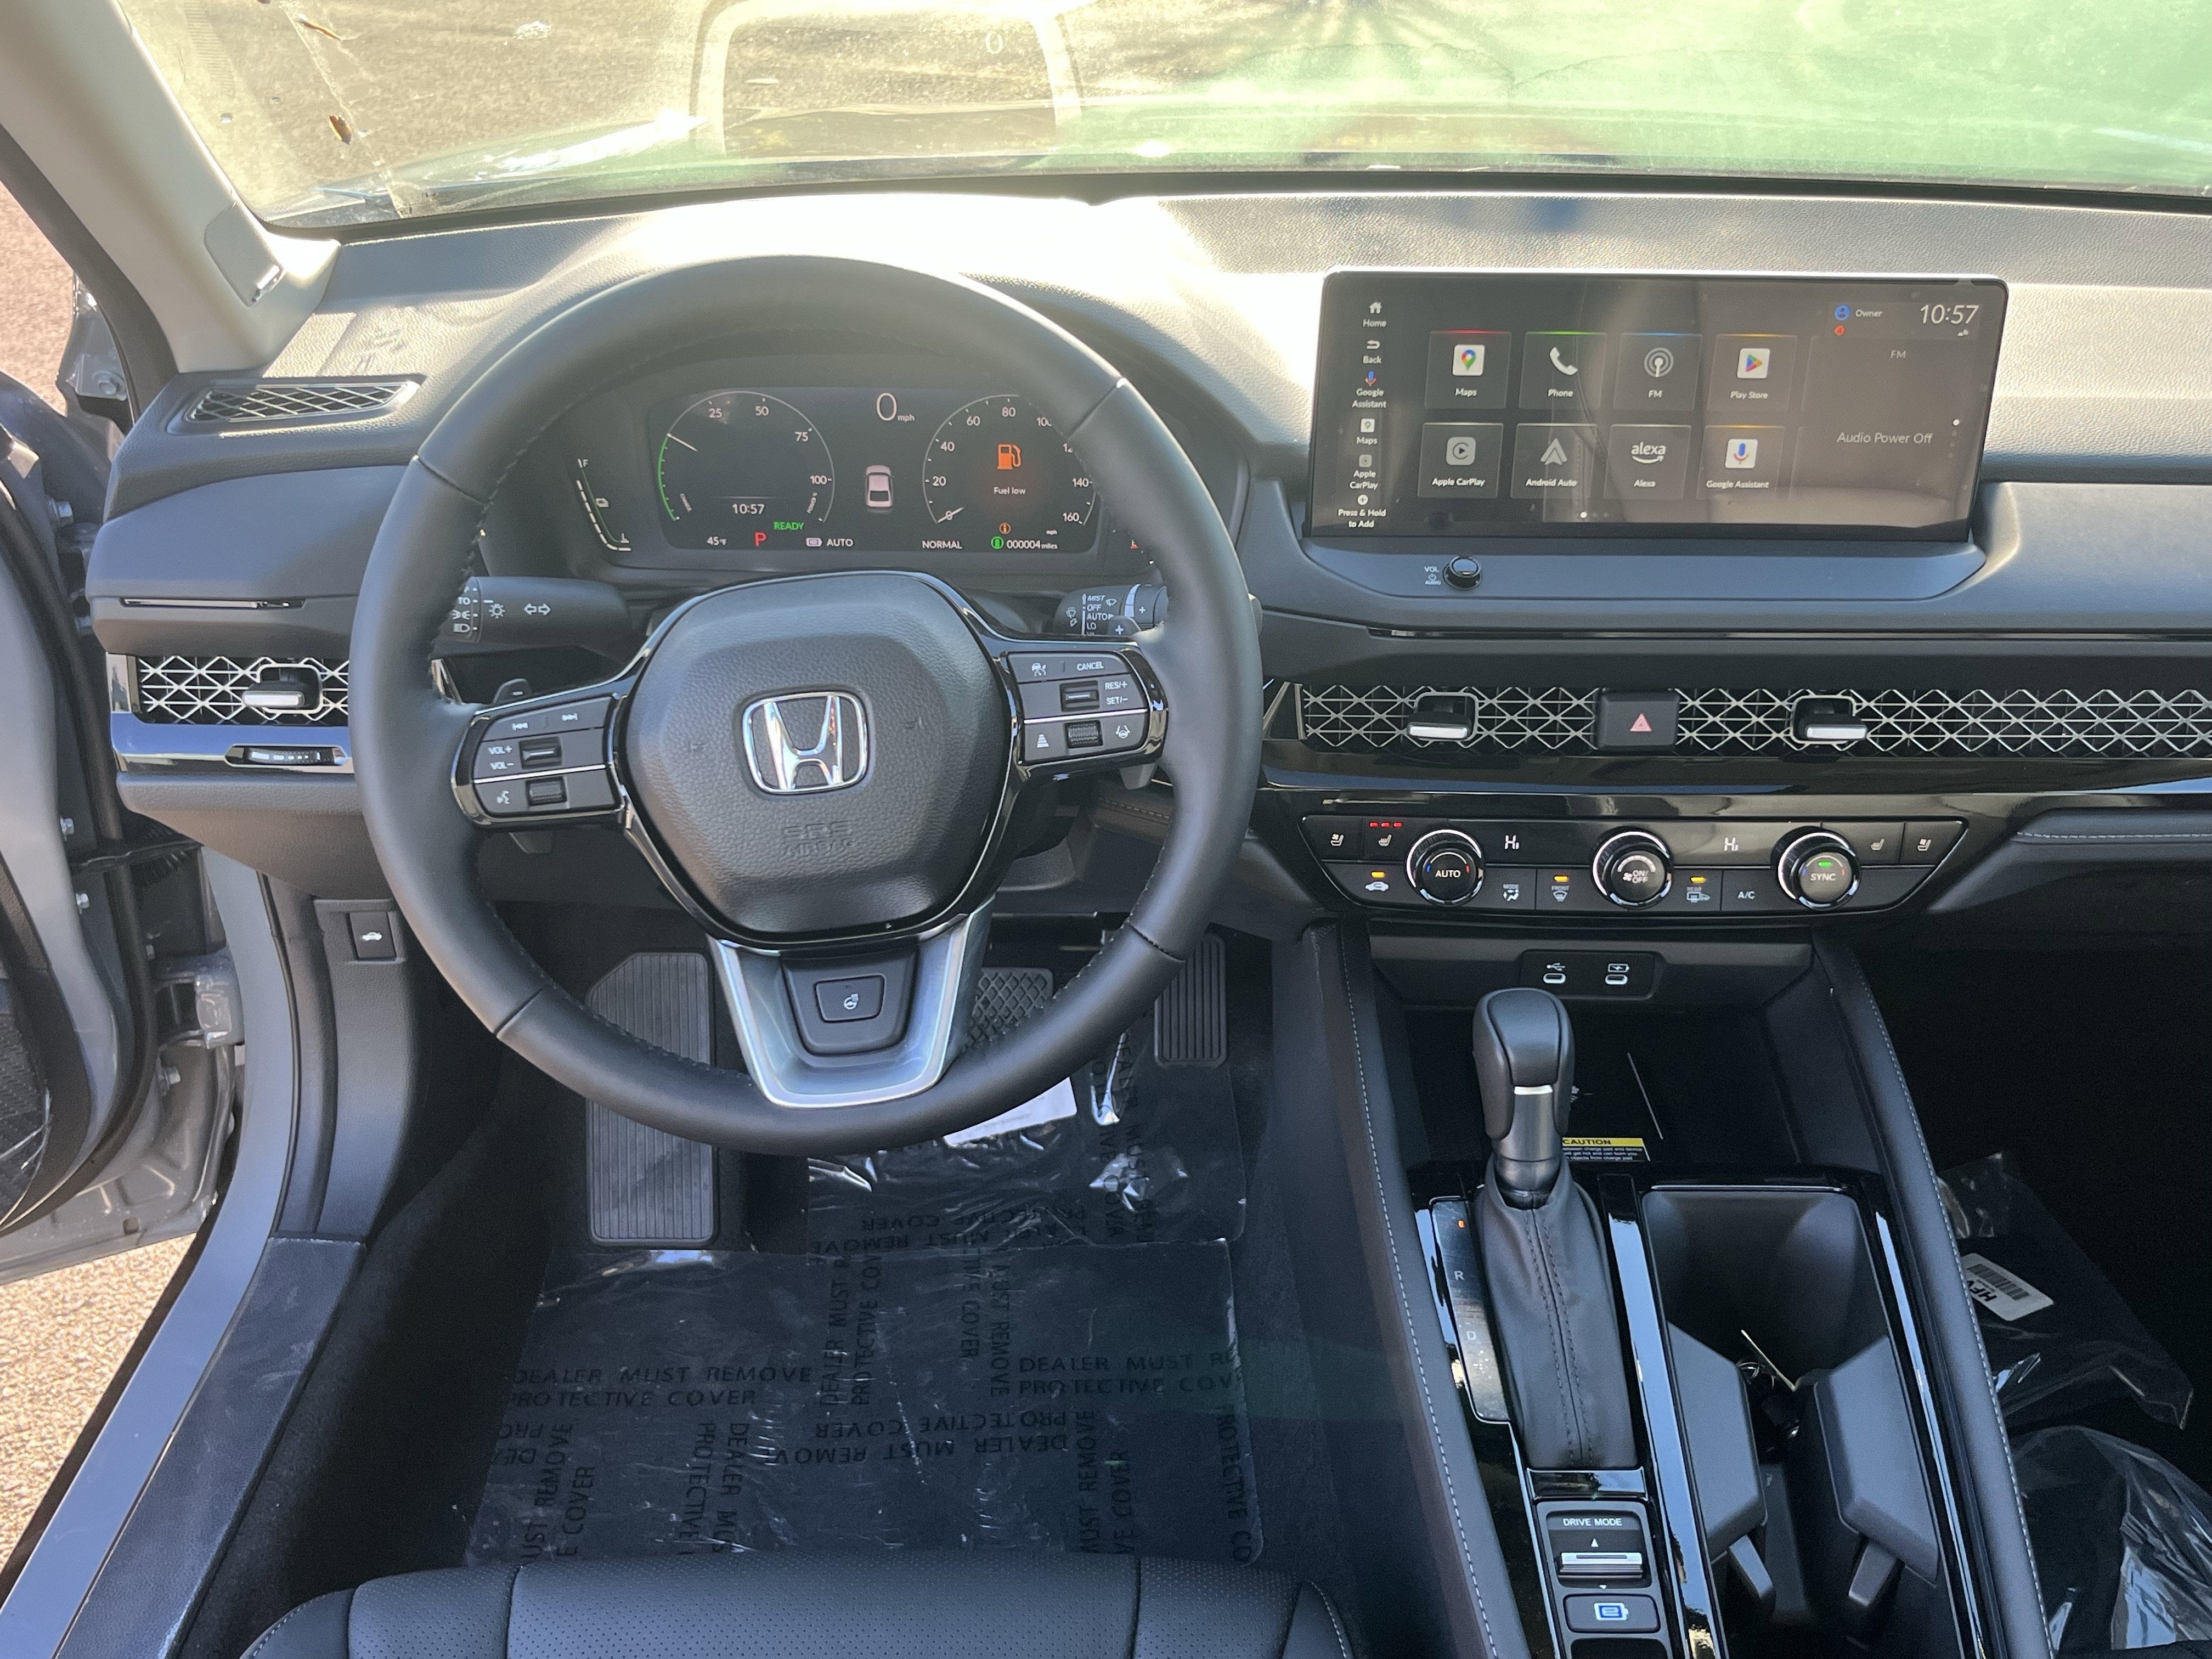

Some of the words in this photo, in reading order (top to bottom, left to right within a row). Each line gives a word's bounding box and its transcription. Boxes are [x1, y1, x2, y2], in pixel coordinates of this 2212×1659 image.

[1920, 304, 1979, 324] 10:57
[1890, 350, 1906, 358] FM
[1363, 356, 1381, 364] Back
[1356, 388, 1384, 398] Google
[1455, 388, 1477, 397] Maps
[1548, 389, 1573, 398] Phone
[1730, 391, 1746, 399] Play
[877, 392, 897, 421] 0
[898, 414, 915, 422] mph
[1352, 400, 1386, 409] Assistant
[709, 408, 722, 417] 25
[755, 407, 769, 416] 50
[1002, 407, 1015, 417] 80
[966, 416, 980, 426] 60
[795, 432, 808, 442] 75
[1356, 437, 1378, 445] Maps
[1837, 432, 1871, 443] Audio
[1874, 433, 1909, 443] Power
[1914, 433, 1933, 444] Off
[940, 442, 955, 452] 40
[1631, 442, 1666, 455] alexa
[1353, 470, 1376, 479] Apple
[810, 476, 827, 484] 100
[933, 476, 946, 486] 20
[1073, 478, 1089, 487] 140
[1432, 478, 1454, 487] Apple
[1457, 478, 1485, 487] CarPlay
[1525, 478, 1556, 487] Android
[1634, 479, 1656, 488] Alexa
[1706, 480, 1733, 489] Google
[1735, 480, 1769, 488] Assistant
[1349, 482, 1378, 490] CarPlay
[732, 504, 765, 515] 10:57
[1338, 509, 1358, 517] Press
[1368, 509, 1386, 517] Hold
[1063, 513, 1080, 522] 160
[774, 522, 804, 530] READY
[1358, 520, 1374, 528] Add
[755, 531, 767, 547] P
[827, 538, 854, 547] AUTO
[922, 541, 962, 549] NORMAL
[1007, 540, 1041, 549] 000004
[1076, 661, 1104, 671] CANCEL
[1435, 870, 1461, 878] AUTO
[1738, 891, 1755, 900] A/C
[862, 1215, 940, 1231] COVER
[810, 1235, 909, 1254] REMOVE
[1454, 1271, 1464, 1280] R
[829, 1280, 849, 1327] MUST
[961, 1300, 980, 1358] COVER
[1466, 1331, 1477, 1341] D
[851, 1300, 878, 1406] PROTECTIVE
[990, 1321, 1010, 1396] REMOVE
[1020, 1357, 1109, 1372] DEALER
[1126, 1354, 1192, 1370] MUST
[619, 1367, 691, 1384] MUST
[707, 1367, 812, 1383] REMOVE
[1020, 1379, 1164, 1394] PROTECTIVE
[668, 1390, 756, 1406] COVER
[919, 1411, 1066, 1432] PROTECTIVE
[816, 1419, 905, 1439] COVER
[884, 1438, 955, 1460] MUST
[975, 1435, 1067, 1454] DEALER
[1076, 1410, 1097, 1491] REMOVE
[720, 1423, 749, 1495] DEALER
[534, 1424, 574, 1506] REMOVE
[679, 1423, 715, 1538] PROTECTIVE
[562, 1466, 596, 1534] COVER
[1563, 1518, 1591, 1526] DRIVE
[1594, 1518, 1622, 1526] MODE
